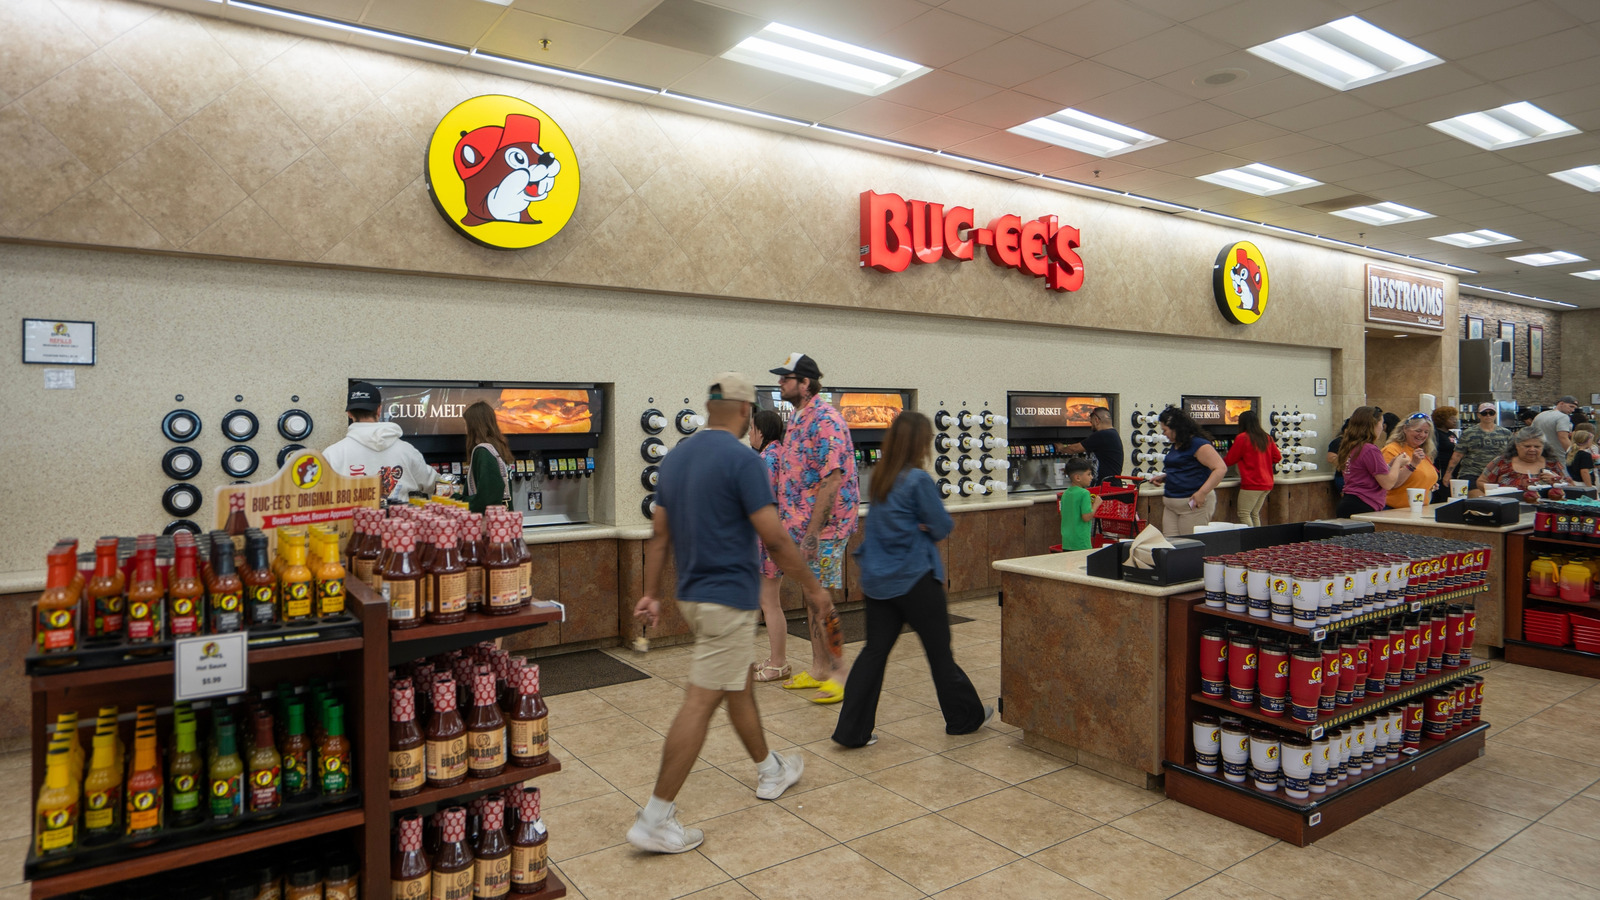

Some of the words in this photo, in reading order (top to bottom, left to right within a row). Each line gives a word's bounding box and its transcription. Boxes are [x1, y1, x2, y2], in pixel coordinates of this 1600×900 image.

[861, 190, 1084, 292] BUC-EE'S
[1371, 276, 1443, 316] RESTROOMS
[388, 404, 426, 418] CLUB
[430, 404, 466, 418] MELT
[1016, 407, 1036, 416] SLICED
[1037, 407, 1062, 416] BRISKET
[297, 491, 334, 508] ORIGINAL
[336, 490, 351, 505] BBQ
[353, 487, 376, 502] SAUCE
[272, 516, 292, 526] Beaver
[292, 513, 312, 524] Tested,
[312, 511, 329, 521] Beaver
[209, 662, 227, 670] Sauce
[202, 676, 222, 685] $5.99
[480, 745, 502, 758] SAUCE
[441, 757, 455, 768] BBQ
[400, 763, 422, 778] SAUCE
[485, 875, 499, 887] BBQ
[445, 888, 460, 900] BBQ
